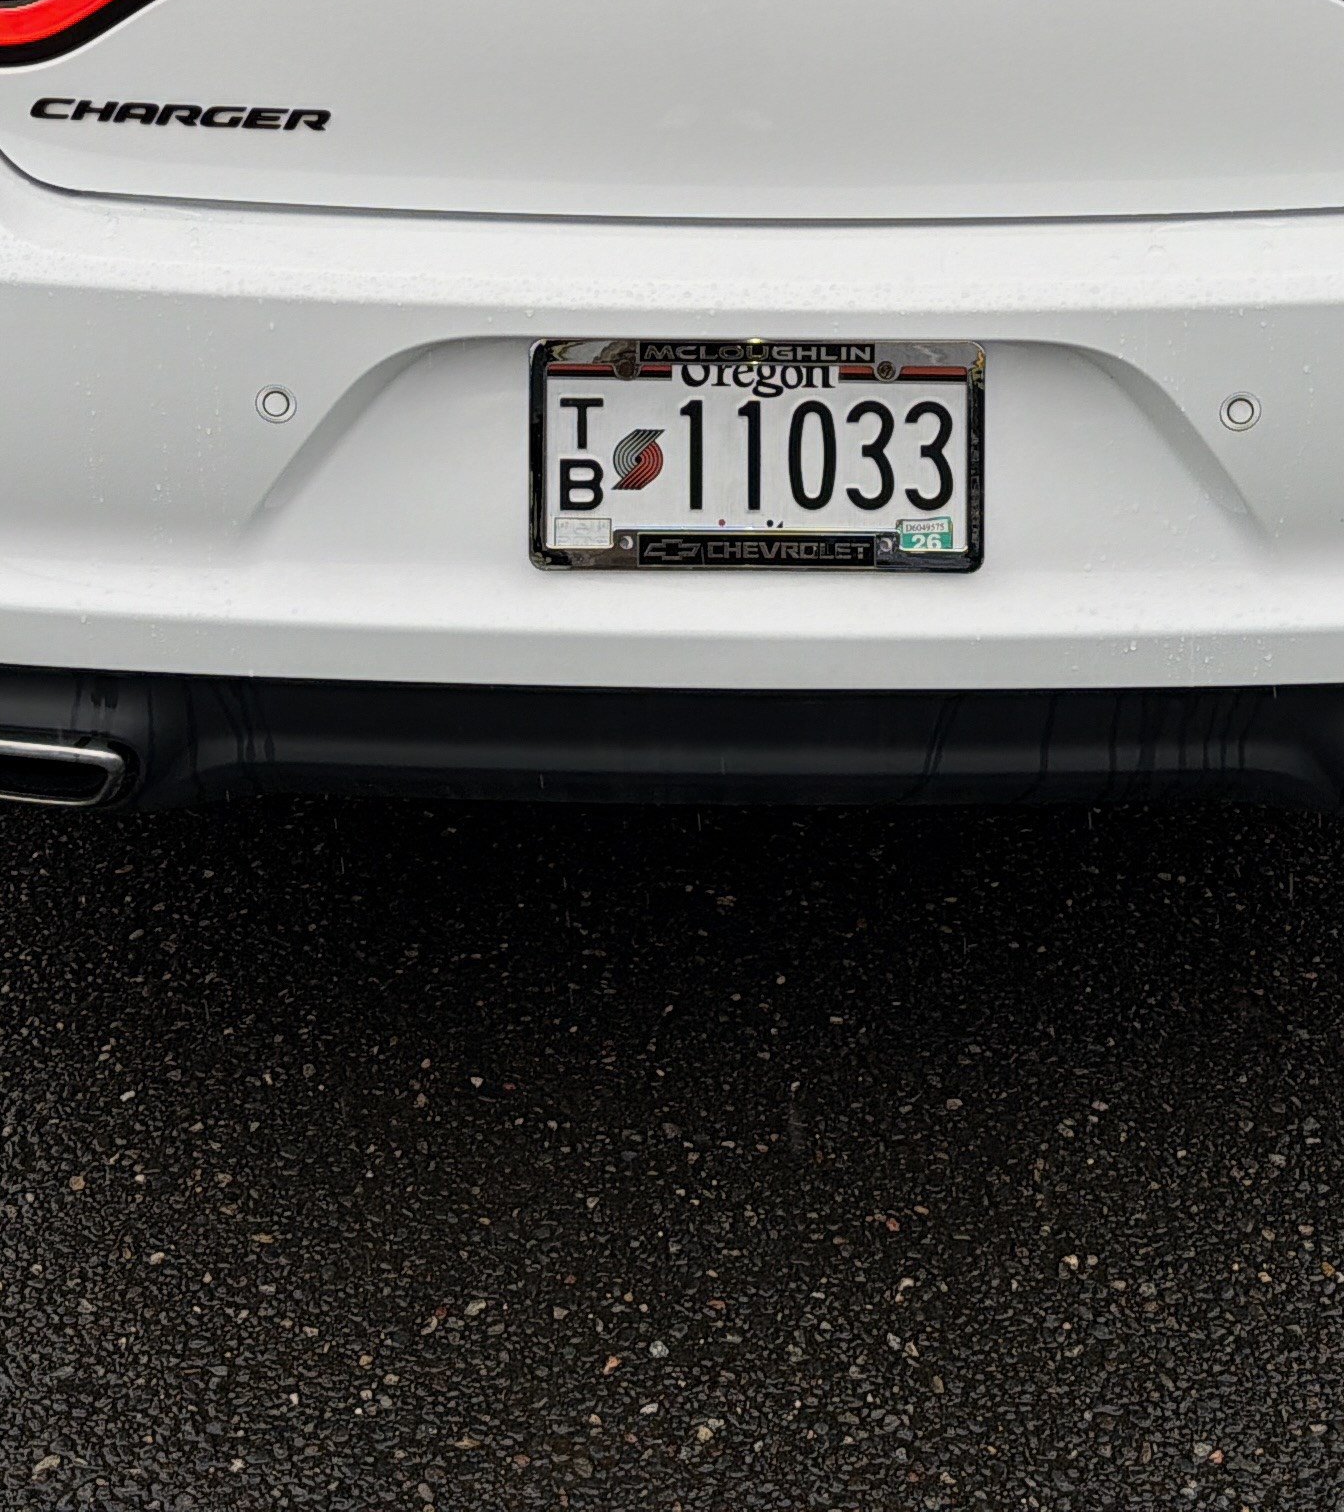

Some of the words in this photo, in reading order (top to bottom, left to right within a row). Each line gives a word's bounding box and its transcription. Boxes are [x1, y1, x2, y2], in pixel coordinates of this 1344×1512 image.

[30, 97, 332, 131] CHARGER
[643, 344, 871, 362] MCLOUGHLIN
[681, 364, 837, 398] Oregon
[679, 399, 954, 511] 11033
[707, 541, 871, 561] CHEVROLET
[911, 533, 943, 549] 26
